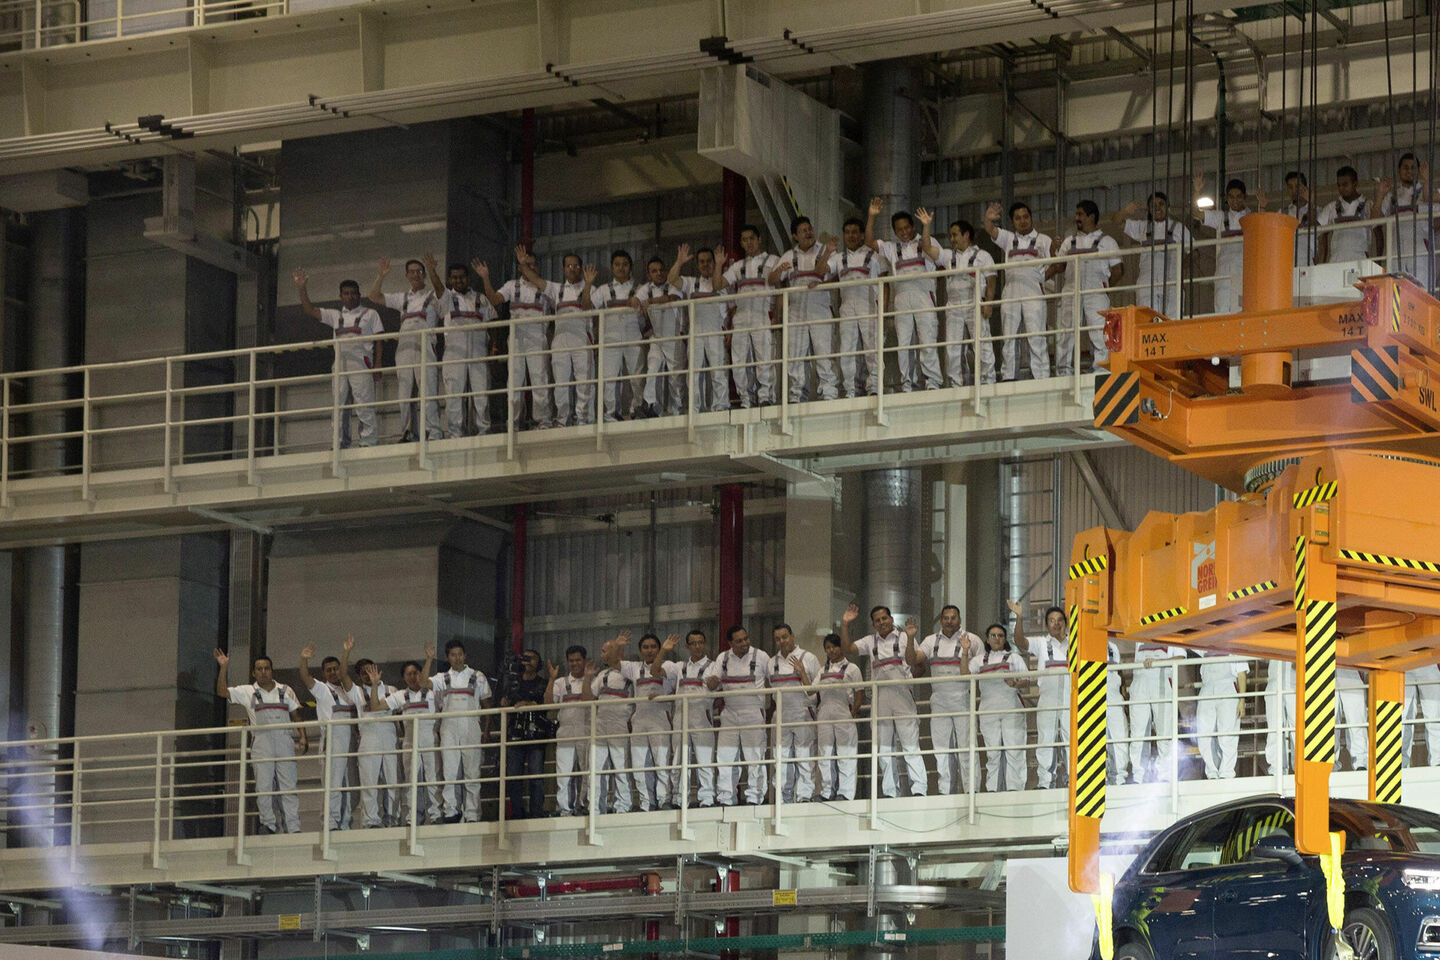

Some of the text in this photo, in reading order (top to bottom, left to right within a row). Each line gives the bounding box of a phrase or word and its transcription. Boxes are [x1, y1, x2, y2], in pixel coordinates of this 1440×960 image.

[1342, 325, 1365, 336] 14 T
[1145, 346, 1166, 357] 14 T
[1419, 387, 1437, 412] SWL
